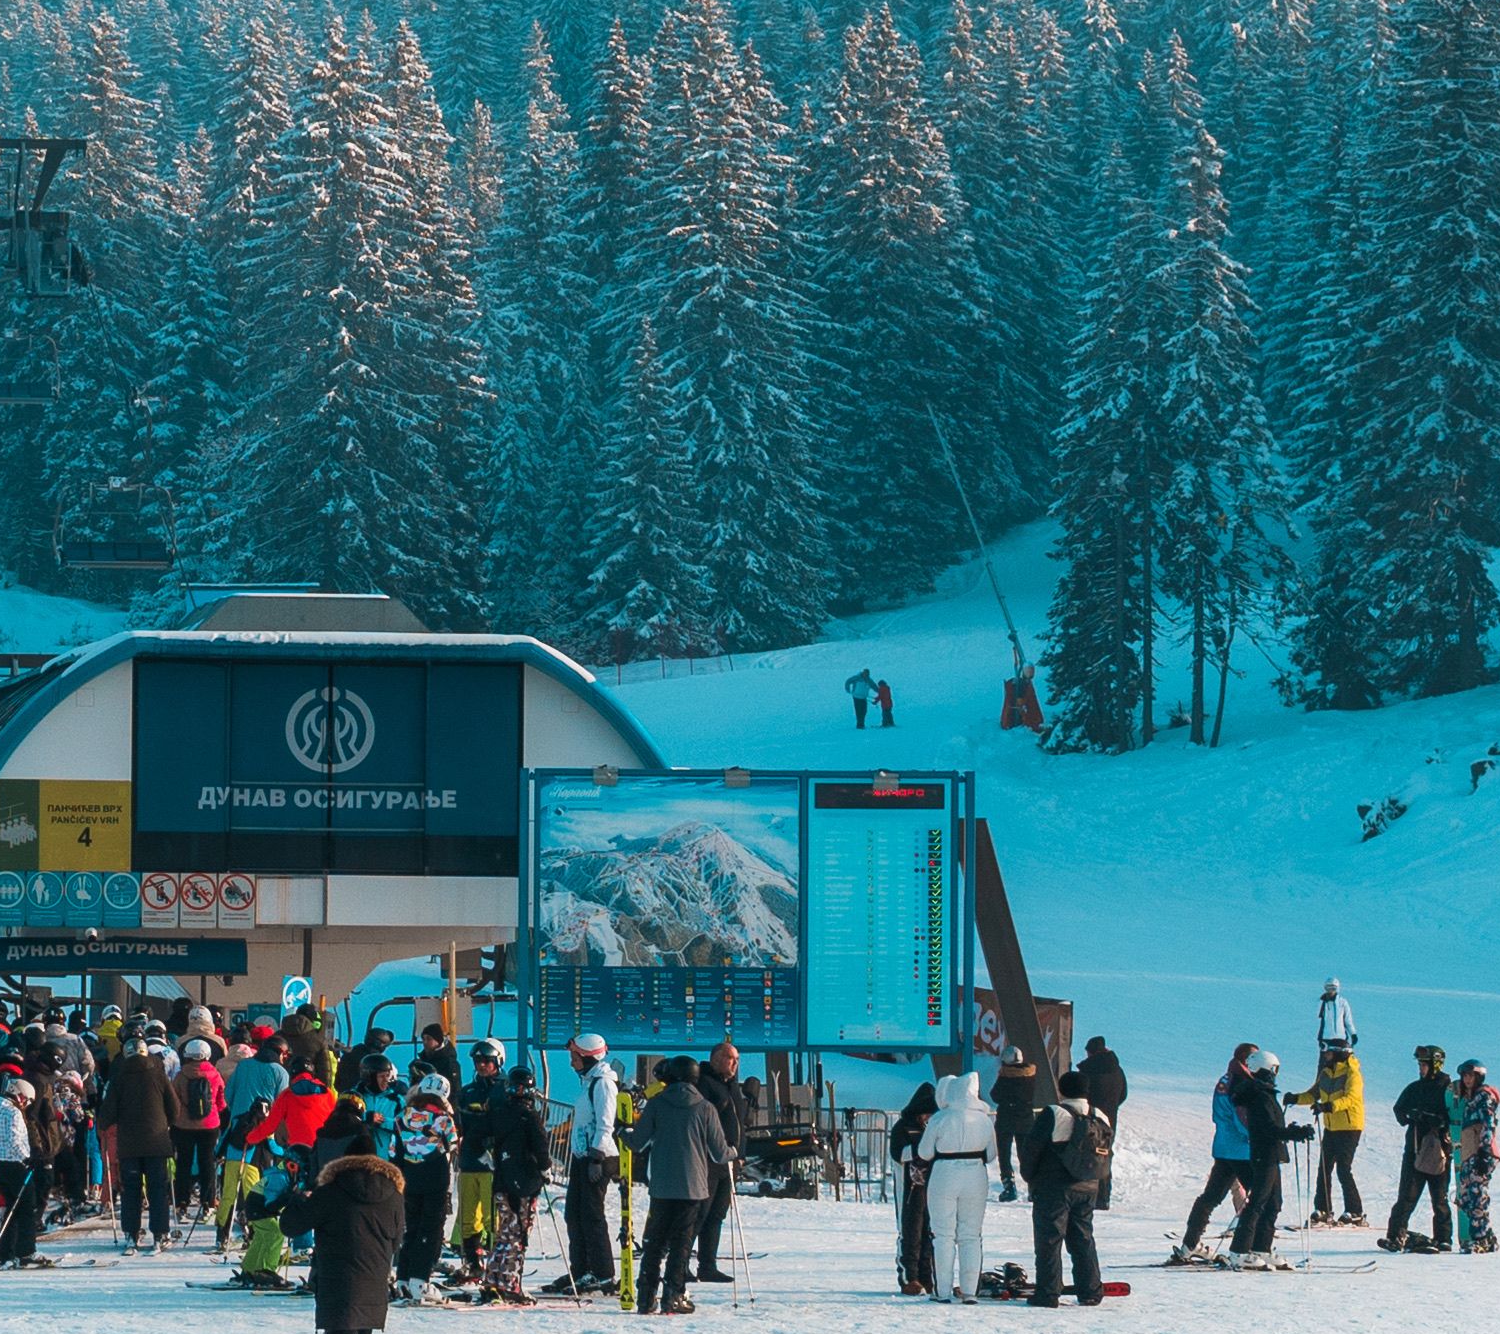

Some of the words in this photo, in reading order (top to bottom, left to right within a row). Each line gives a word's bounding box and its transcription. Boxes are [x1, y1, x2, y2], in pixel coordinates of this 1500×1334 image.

[197, 786, 287, 810] ДУНАВ
[293, 788, 458, 810] ОСИГУРАЊЕ
[99, 816, 119, 824] VRH
[77, 827, 93, 847] 4
[6, 944, 68, 961] ДУНАВ
[72, 941, 189, 956] ОСИГУРАЊЕ
